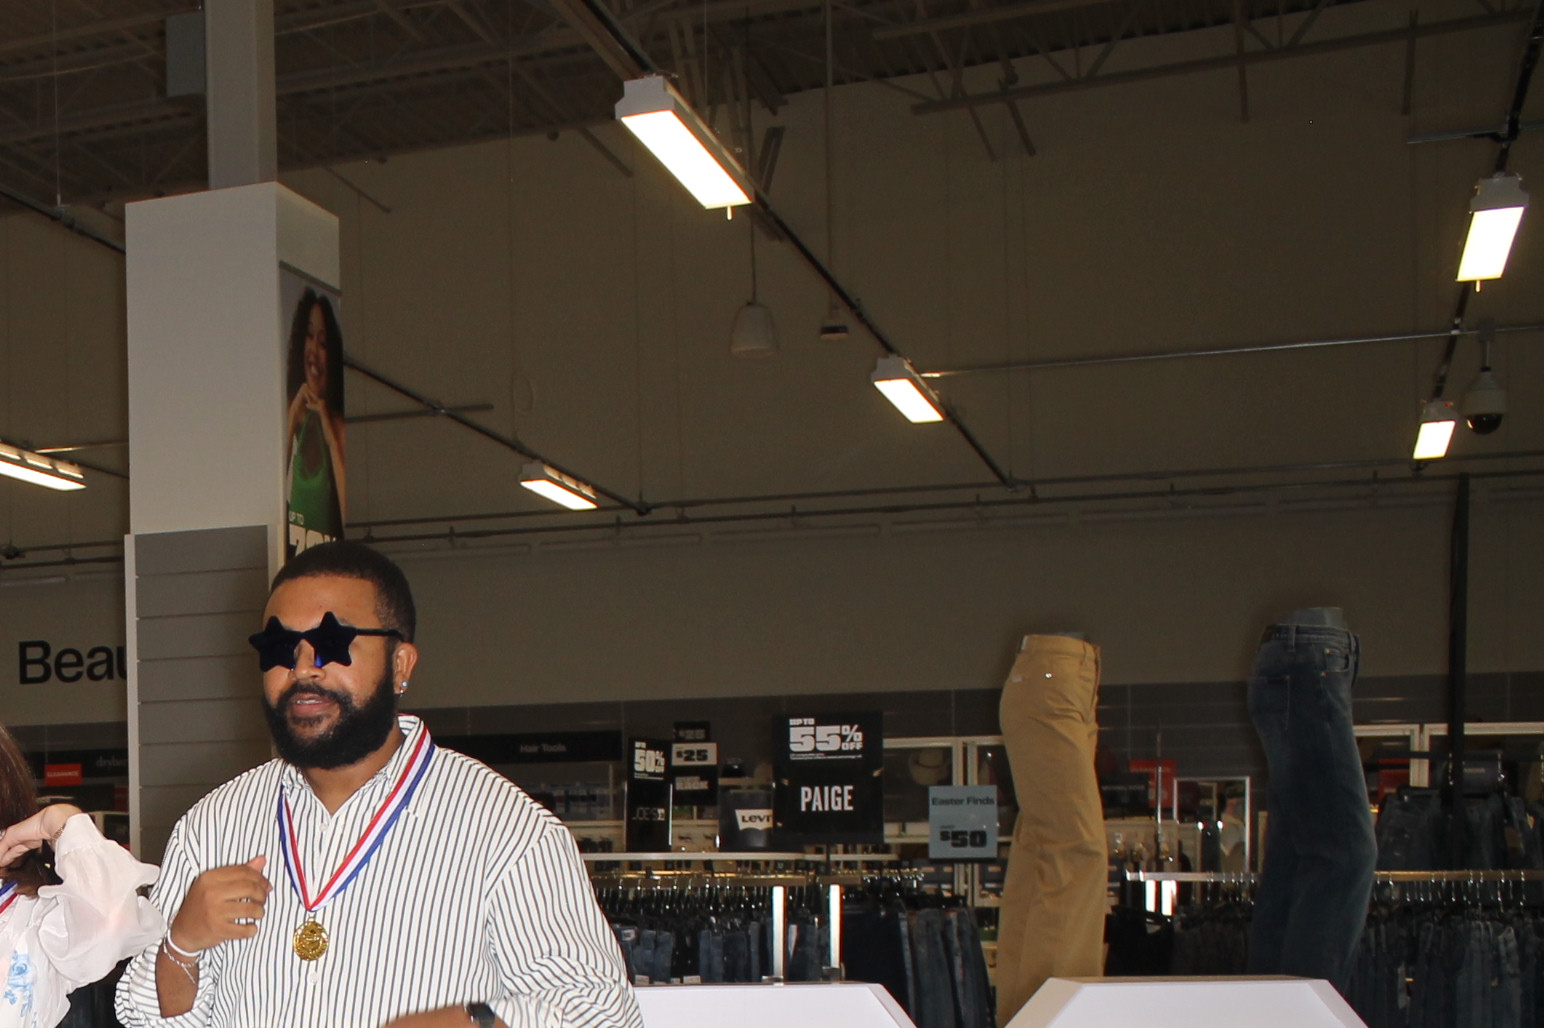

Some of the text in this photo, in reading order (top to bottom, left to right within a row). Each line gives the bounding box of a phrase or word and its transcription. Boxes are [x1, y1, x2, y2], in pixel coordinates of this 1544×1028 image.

[789, 724, 863, 752] 55%
[841, 742, 863, 751] OFF
[634, 749, 665, 773] 50%
[800, 785, 854, 812] PAIGE
[940, 830, 987, 848] $50
